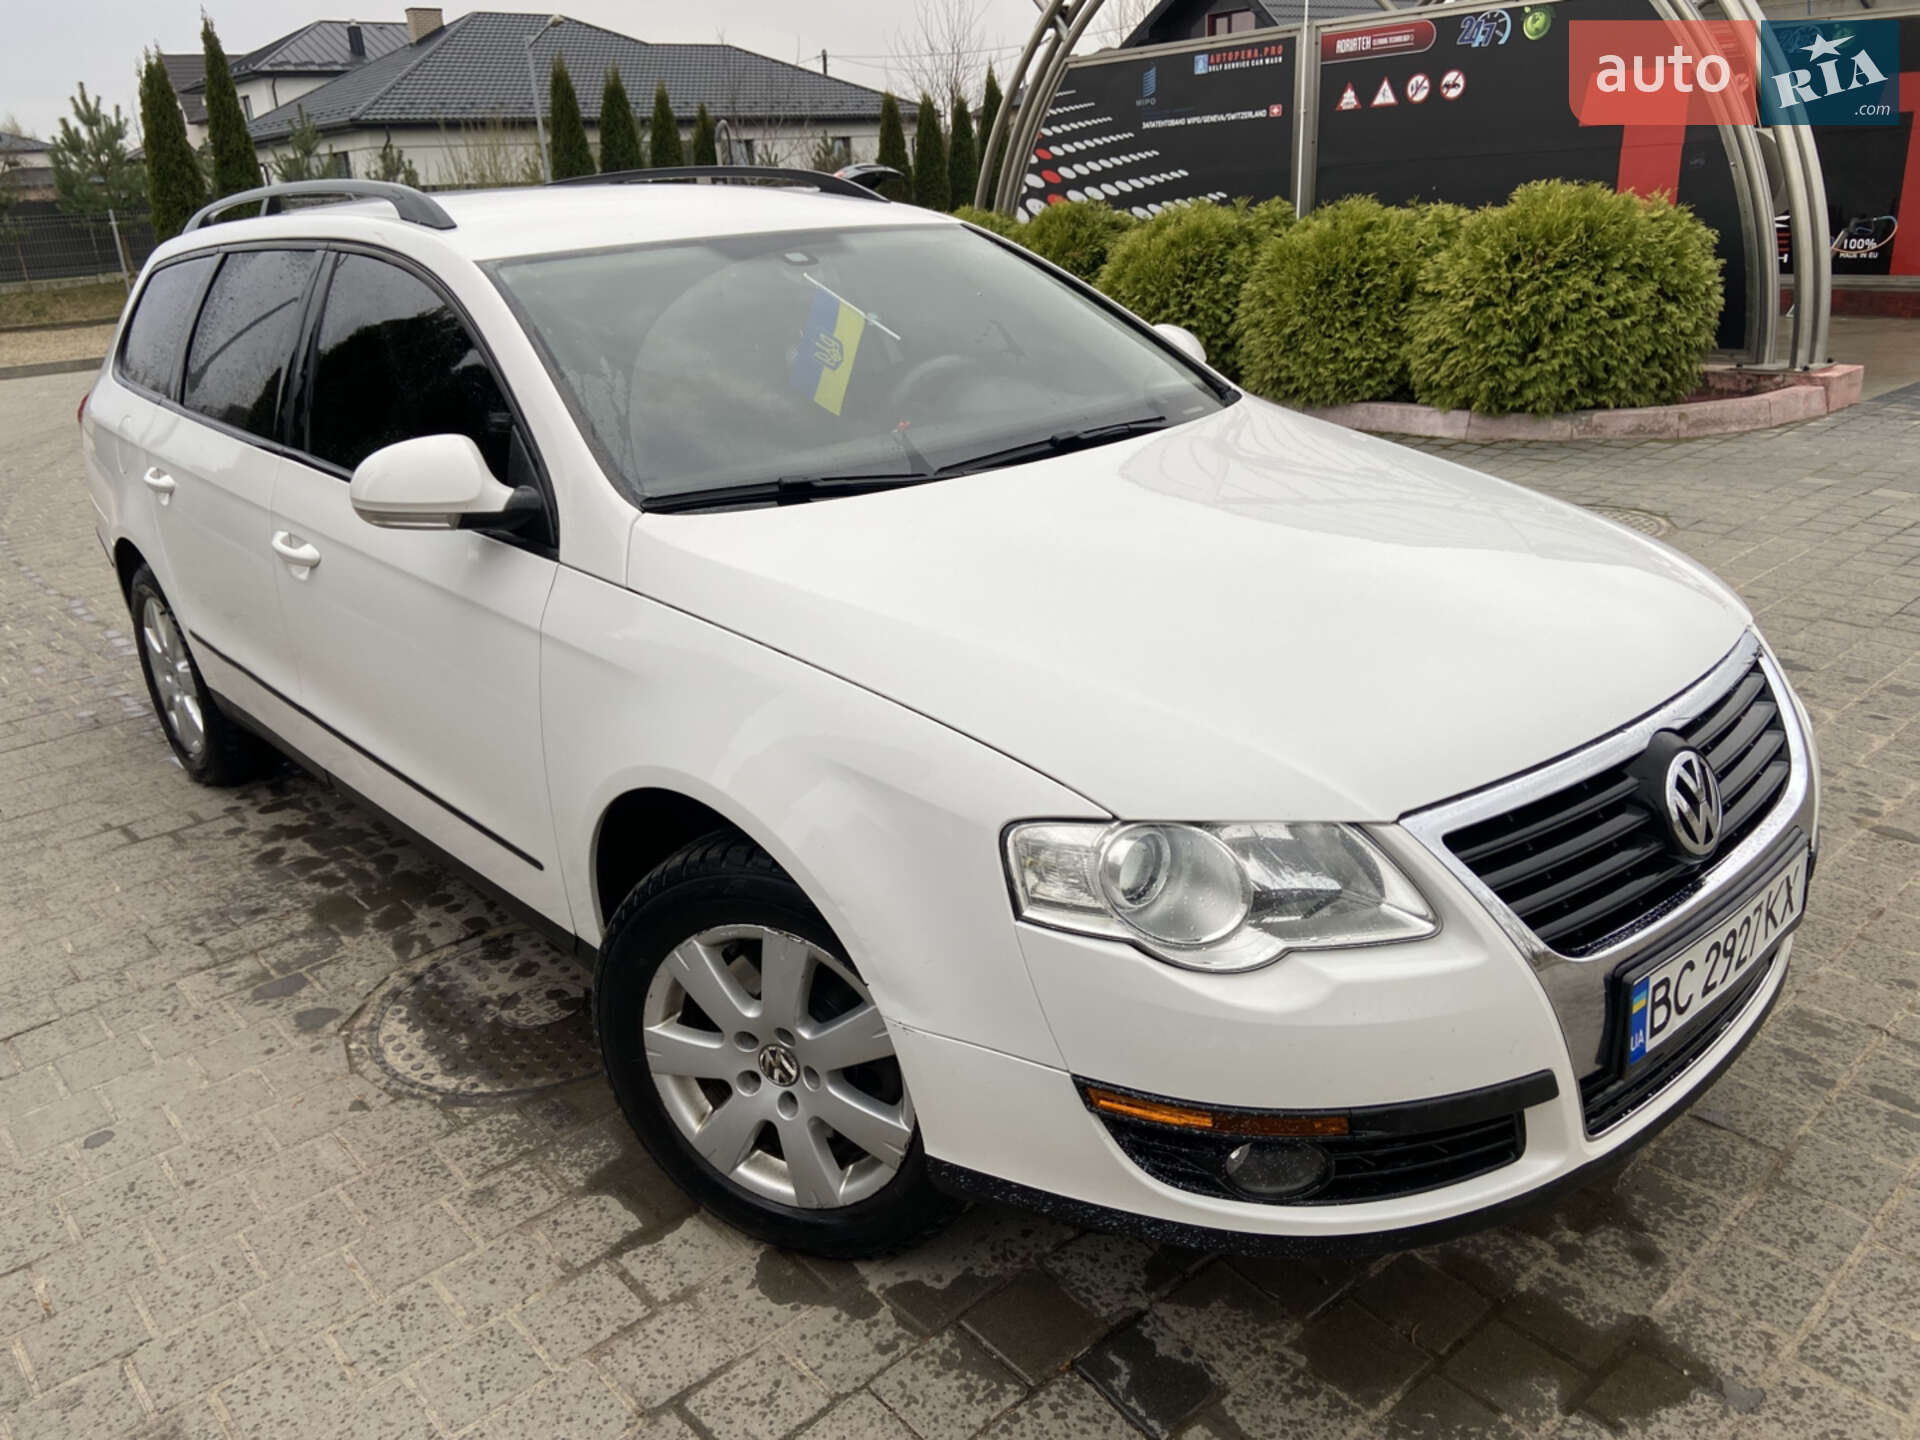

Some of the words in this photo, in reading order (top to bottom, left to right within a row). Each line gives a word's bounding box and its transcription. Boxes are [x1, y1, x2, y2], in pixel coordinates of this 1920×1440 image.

[1223, 60, 1250, 70] SERVICE
[1251, 58, 1264, 67] CAR
[1264, 56, 1282, 65] WASH
[1843, 238, 1877, 250] 100%
[1650, 959, 1696, 1040] BC
[1701, 901, 1764, 999] 2927
[1764, 865, 1800, 940] KX
[1630, 1029, 1645, 1052] UA
